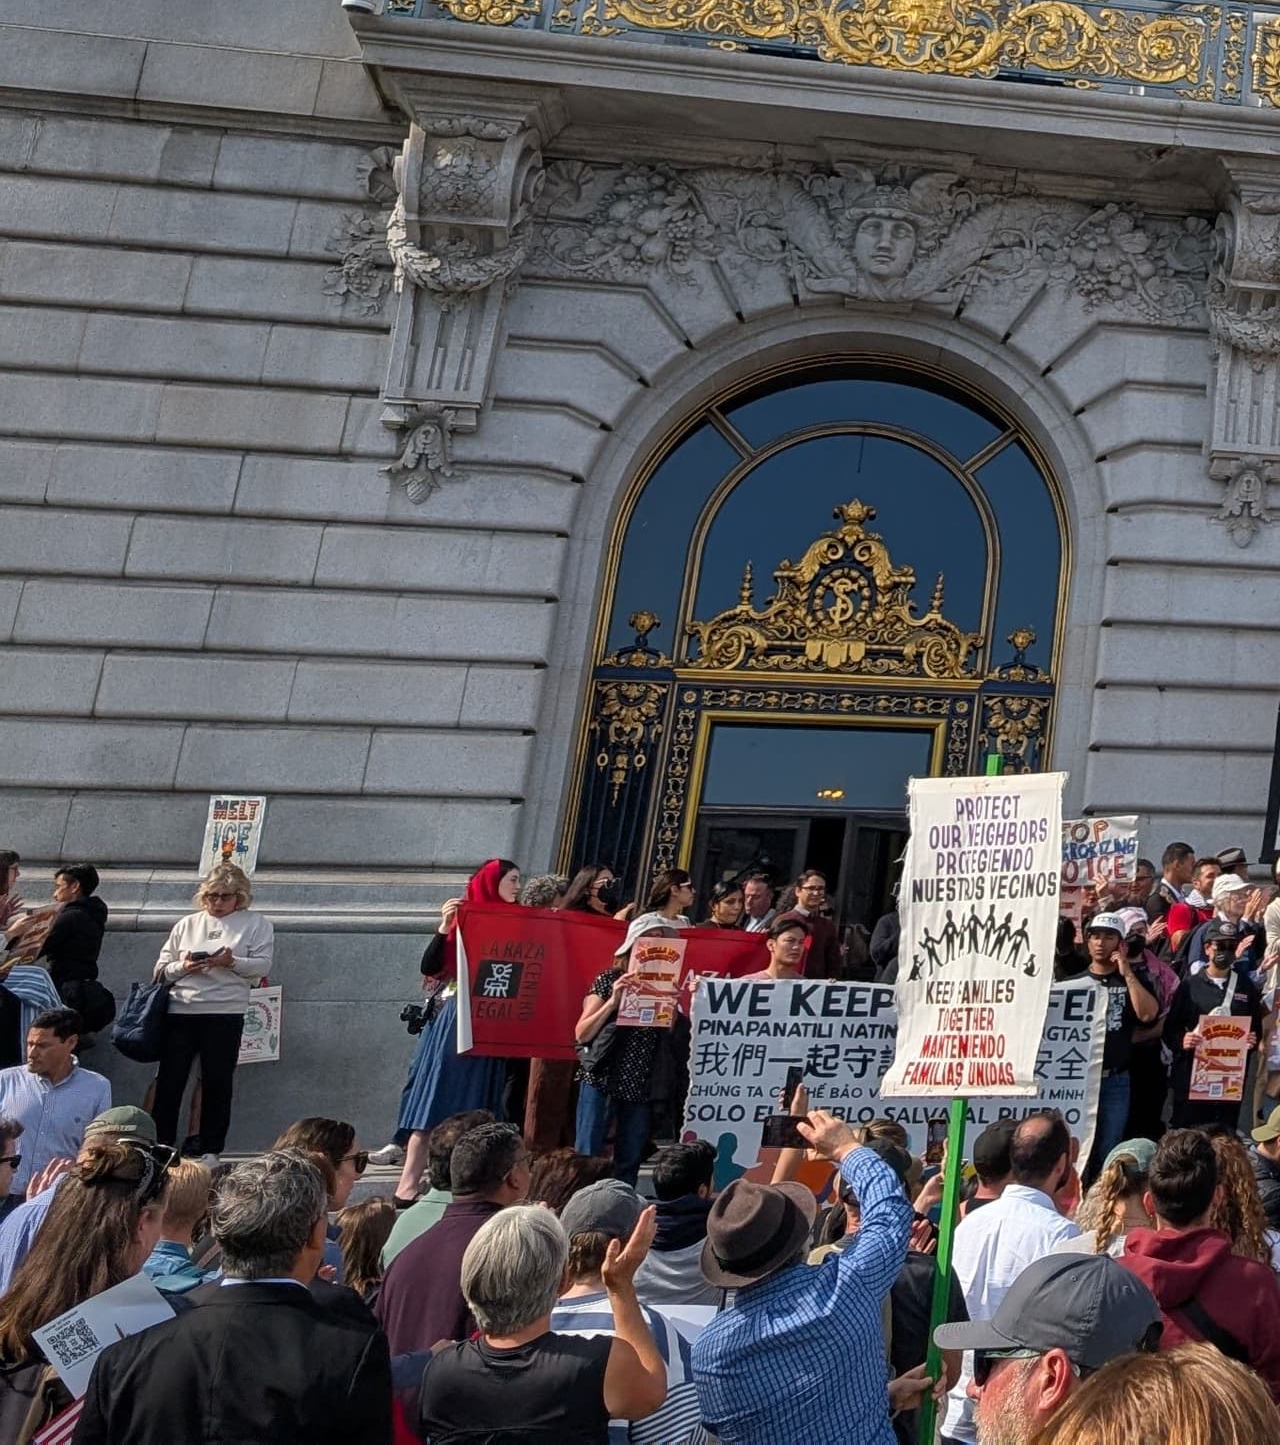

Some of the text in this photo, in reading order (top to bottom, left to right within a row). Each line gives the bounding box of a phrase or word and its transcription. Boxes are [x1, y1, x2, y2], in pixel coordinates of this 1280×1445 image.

[213, 800, 260, 820] MELT
[956, 795, 1020, 821] PROTECT
[212, 822, 251, 852] ICE
[929, 818, 1047, 849] OUR NEIGHBORS
[1062, 820, 1109, 843] TOP
[936, 847, 1033, 875] PROTEGIENDO
[1062, 855, 1127, 883] O ICE
[912, 872, 1057, 903] NUESTROS VECINOS
[707, 982, 775, 1017] WE
[789, 984, 895, 1017] KEEP
[698, 1019, 832, 1038] PINAPANATILI
[840, 1023, 898, 1039] NATIN
[937, 1007, 994, 1031] TOGETHER
[920, 1034, 1005, 1059] MANTENIENDO
[901, 1062, 1015, 1086] FAMILIAS UNIDAS
[690, 1082, 741, 1098] CHÚNG
[747, 1086, 763, 1098] TA
[1050, 1086, 1084, 1100] MÌNH
[686, 1105, 745, 1122] SOLO
